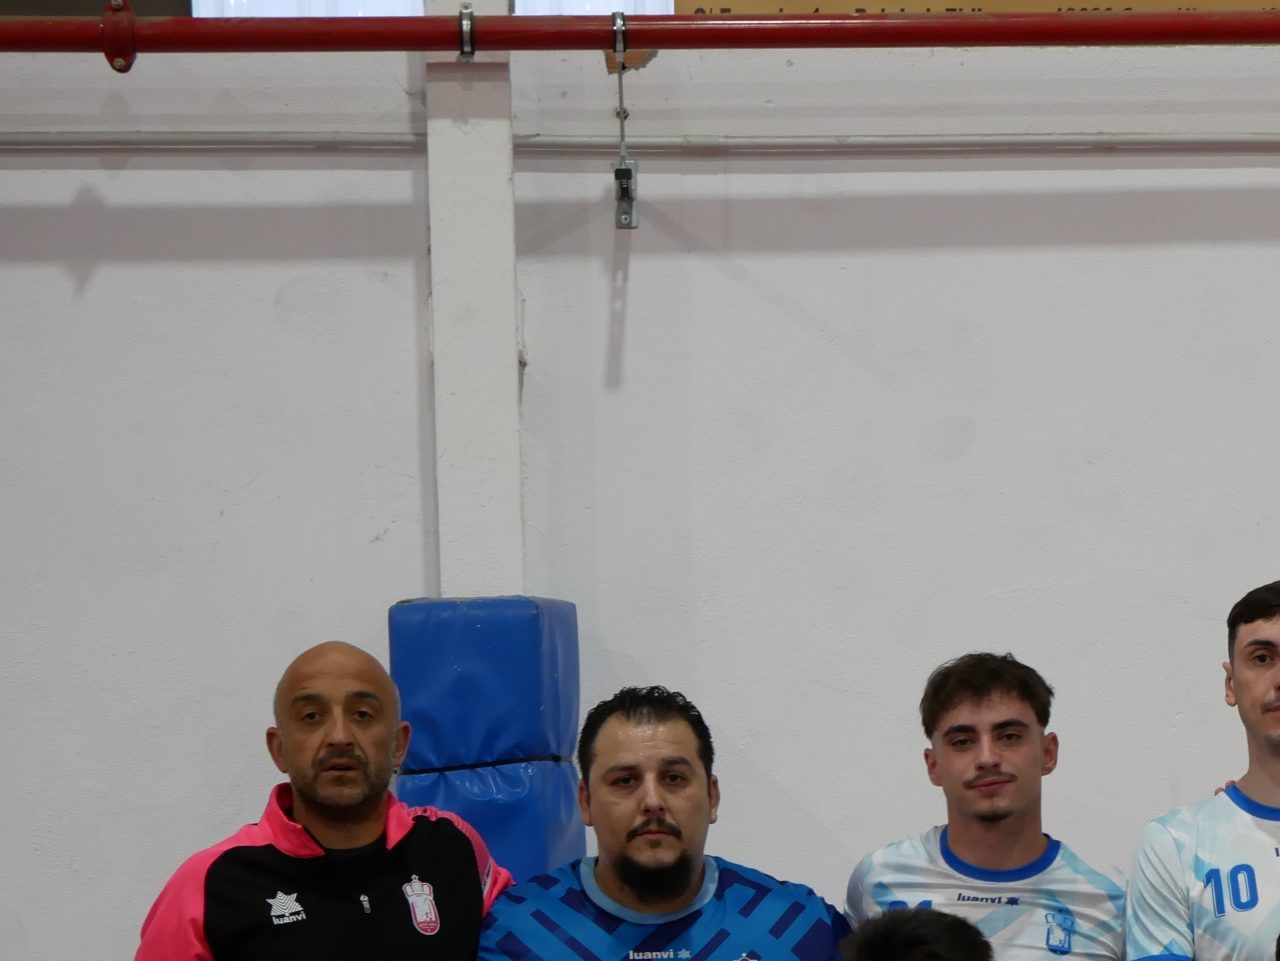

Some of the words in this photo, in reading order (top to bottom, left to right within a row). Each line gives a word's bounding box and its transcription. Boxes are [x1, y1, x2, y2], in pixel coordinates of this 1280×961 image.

[1203, 863, 1259, 918] 10
[957, 892, 1001, 905] luanvi
[629, 948, 674, 960] luanvi
